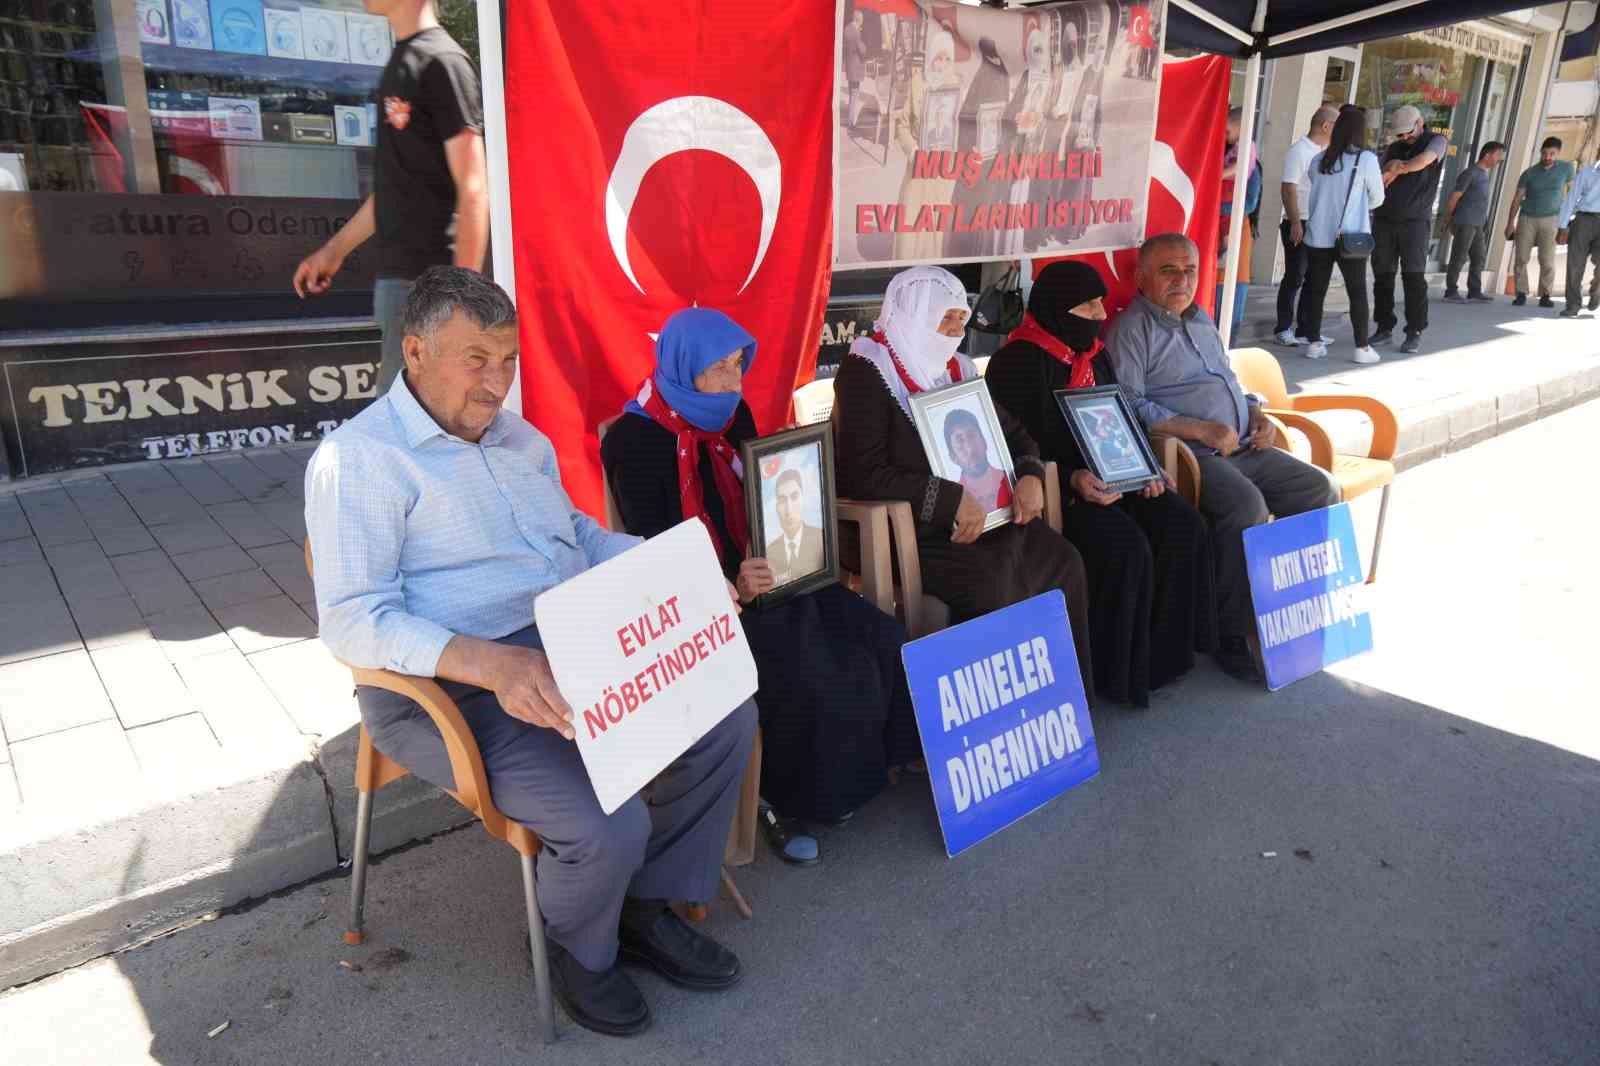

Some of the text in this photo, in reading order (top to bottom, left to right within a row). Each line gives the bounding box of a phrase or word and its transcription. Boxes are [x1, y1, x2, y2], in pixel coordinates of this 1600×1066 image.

[912, 146, 1103, 189] MUŞ ANNELERİ
[66, 205, 212, 237] atura
[856, 194, 1134, 234] EVLATLARINI İSTİYOR
[307, 362, 383, 403] SE
[142, 423, 296, 460] TELEFON
[1269, 547, 1304, 592] ARTIK
[616, 594, 682, 658] EVLAT
[582, 613, 737, 740] NÖBETİNDEYİZ
[937, 635, 1056, 733] ANNELER
[945, 702, 1083, 814] DİRENİYOR
